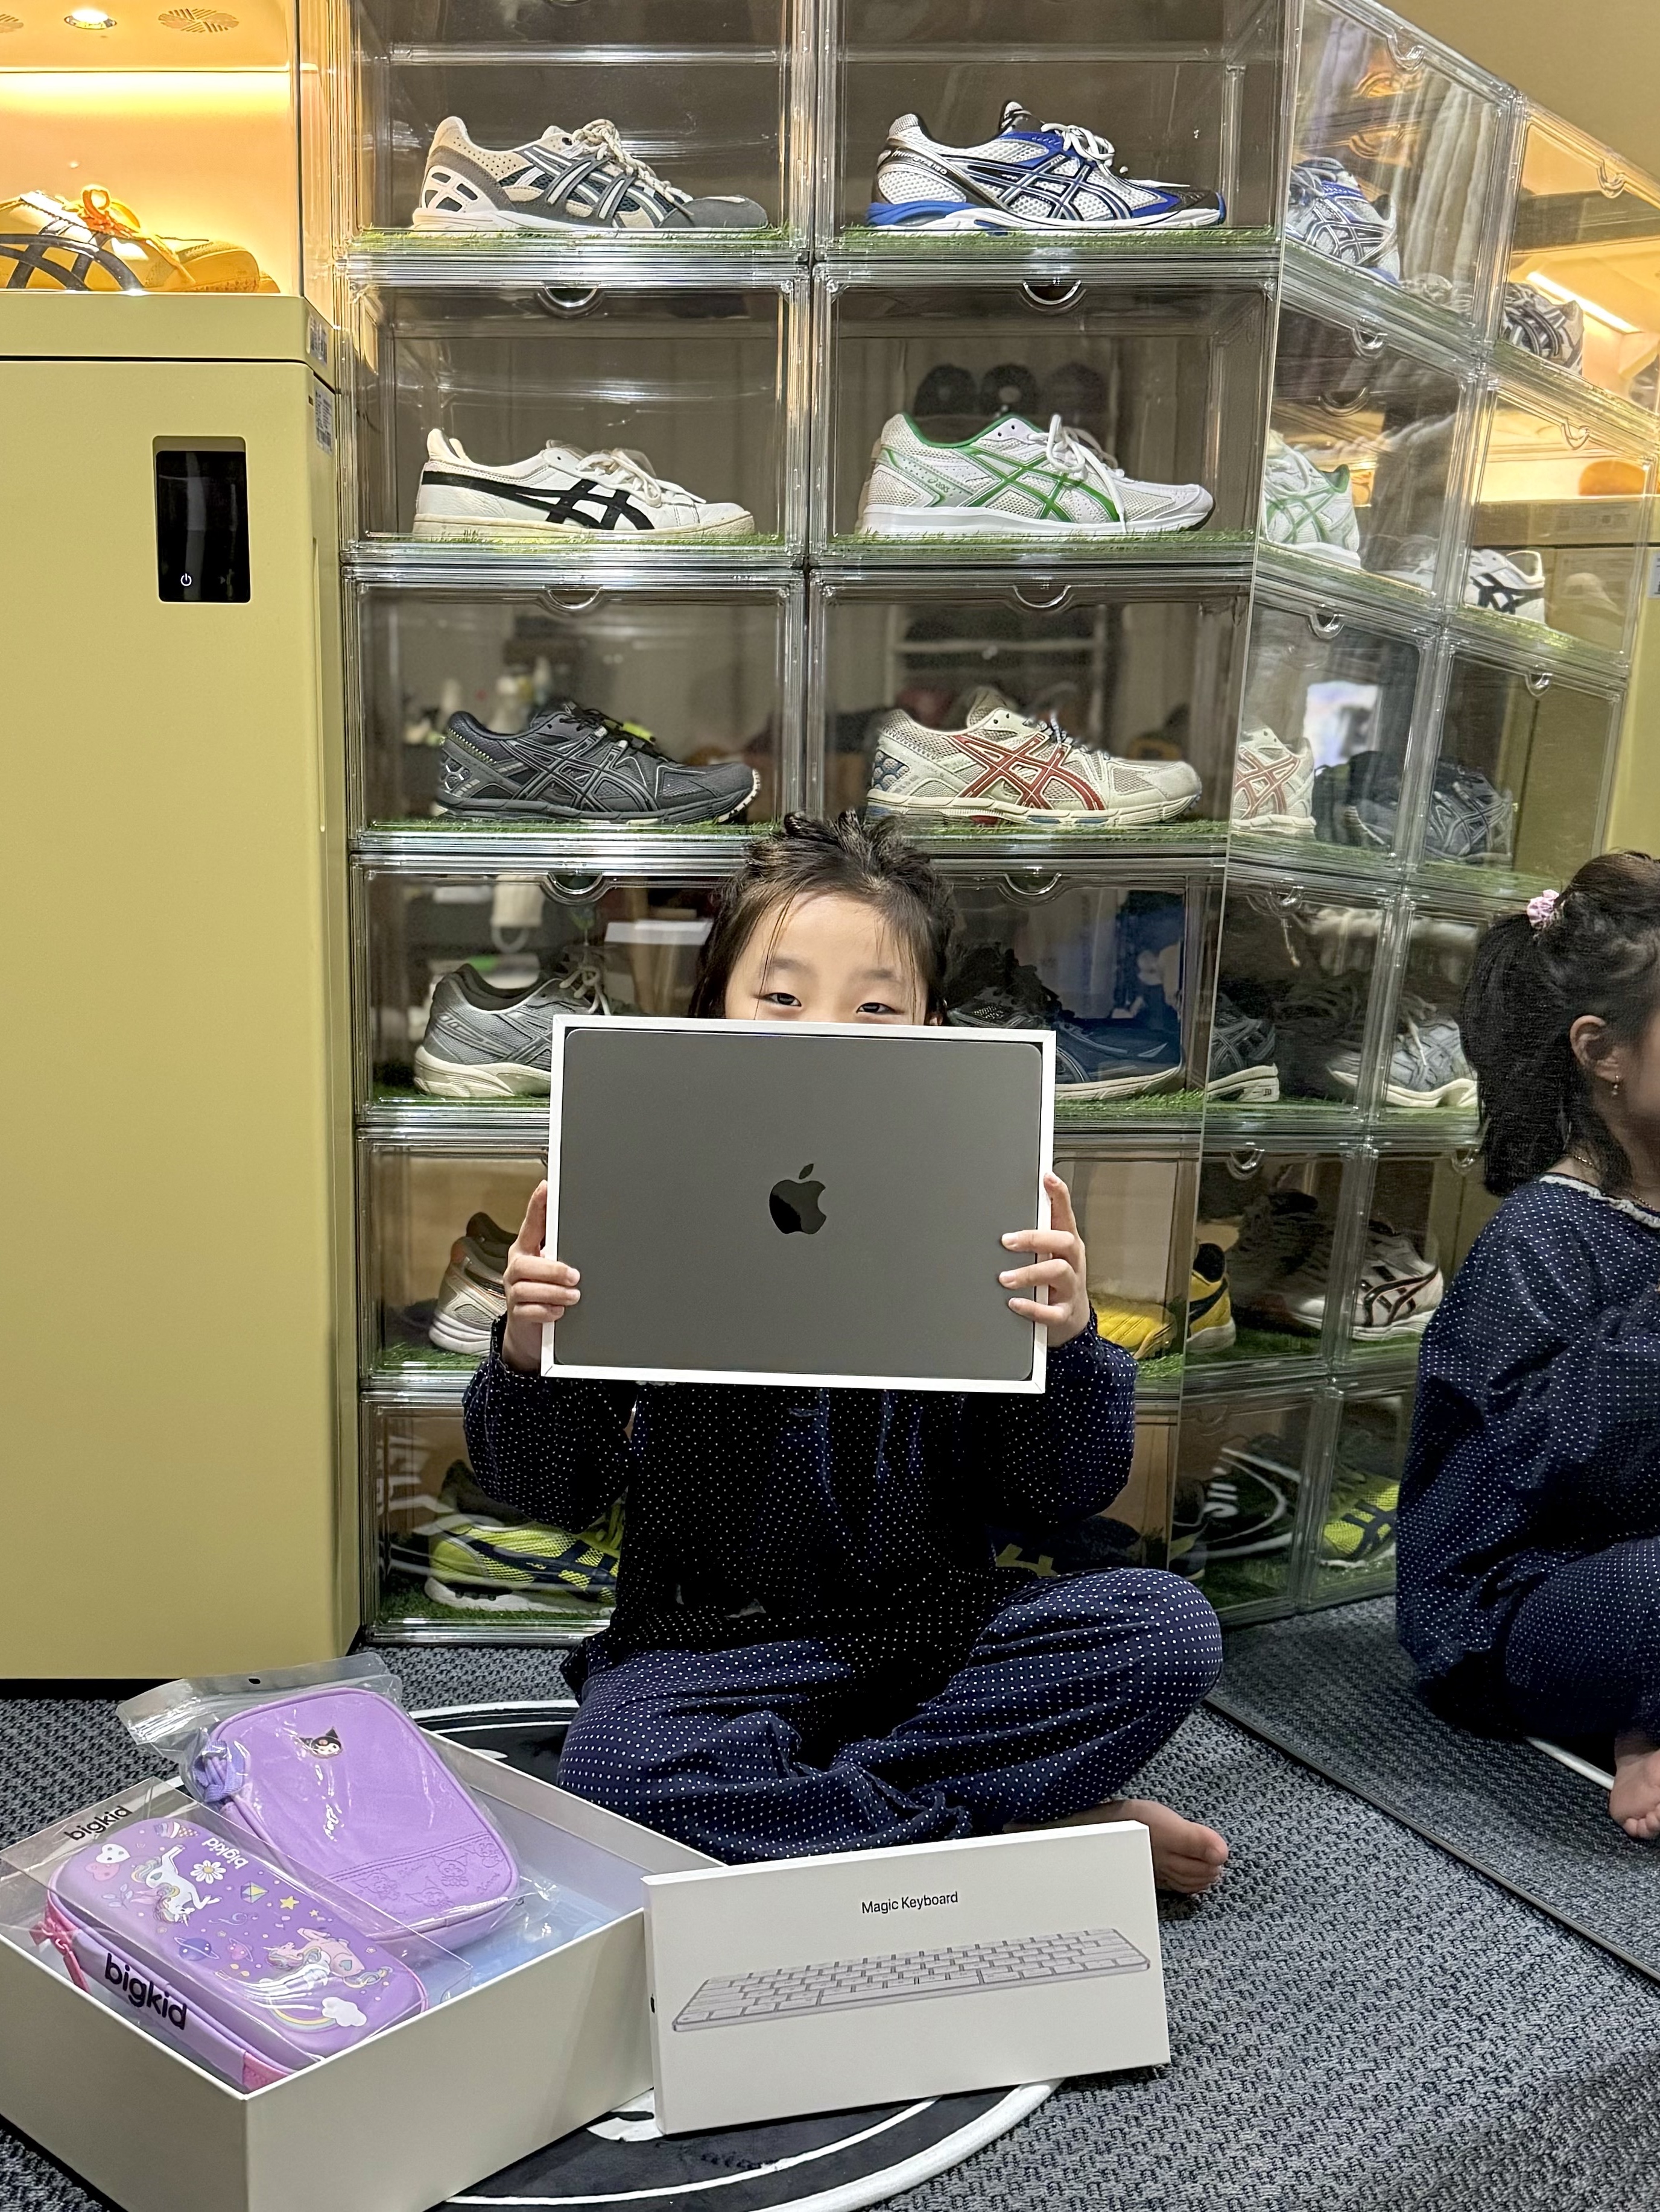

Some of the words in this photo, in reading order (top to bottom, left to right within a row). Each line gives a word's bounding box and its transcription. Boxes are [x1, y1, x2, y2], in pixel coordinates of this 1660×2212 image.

[63, 1806, 133, 1841] bigkid
[201, 1838, 249, 1869] bigkid
[861, 1898, 899, 1914] Magic
[901, 1891, 958, 1910] Keyboard
[104, 1953, 188, 2030] bigkid
